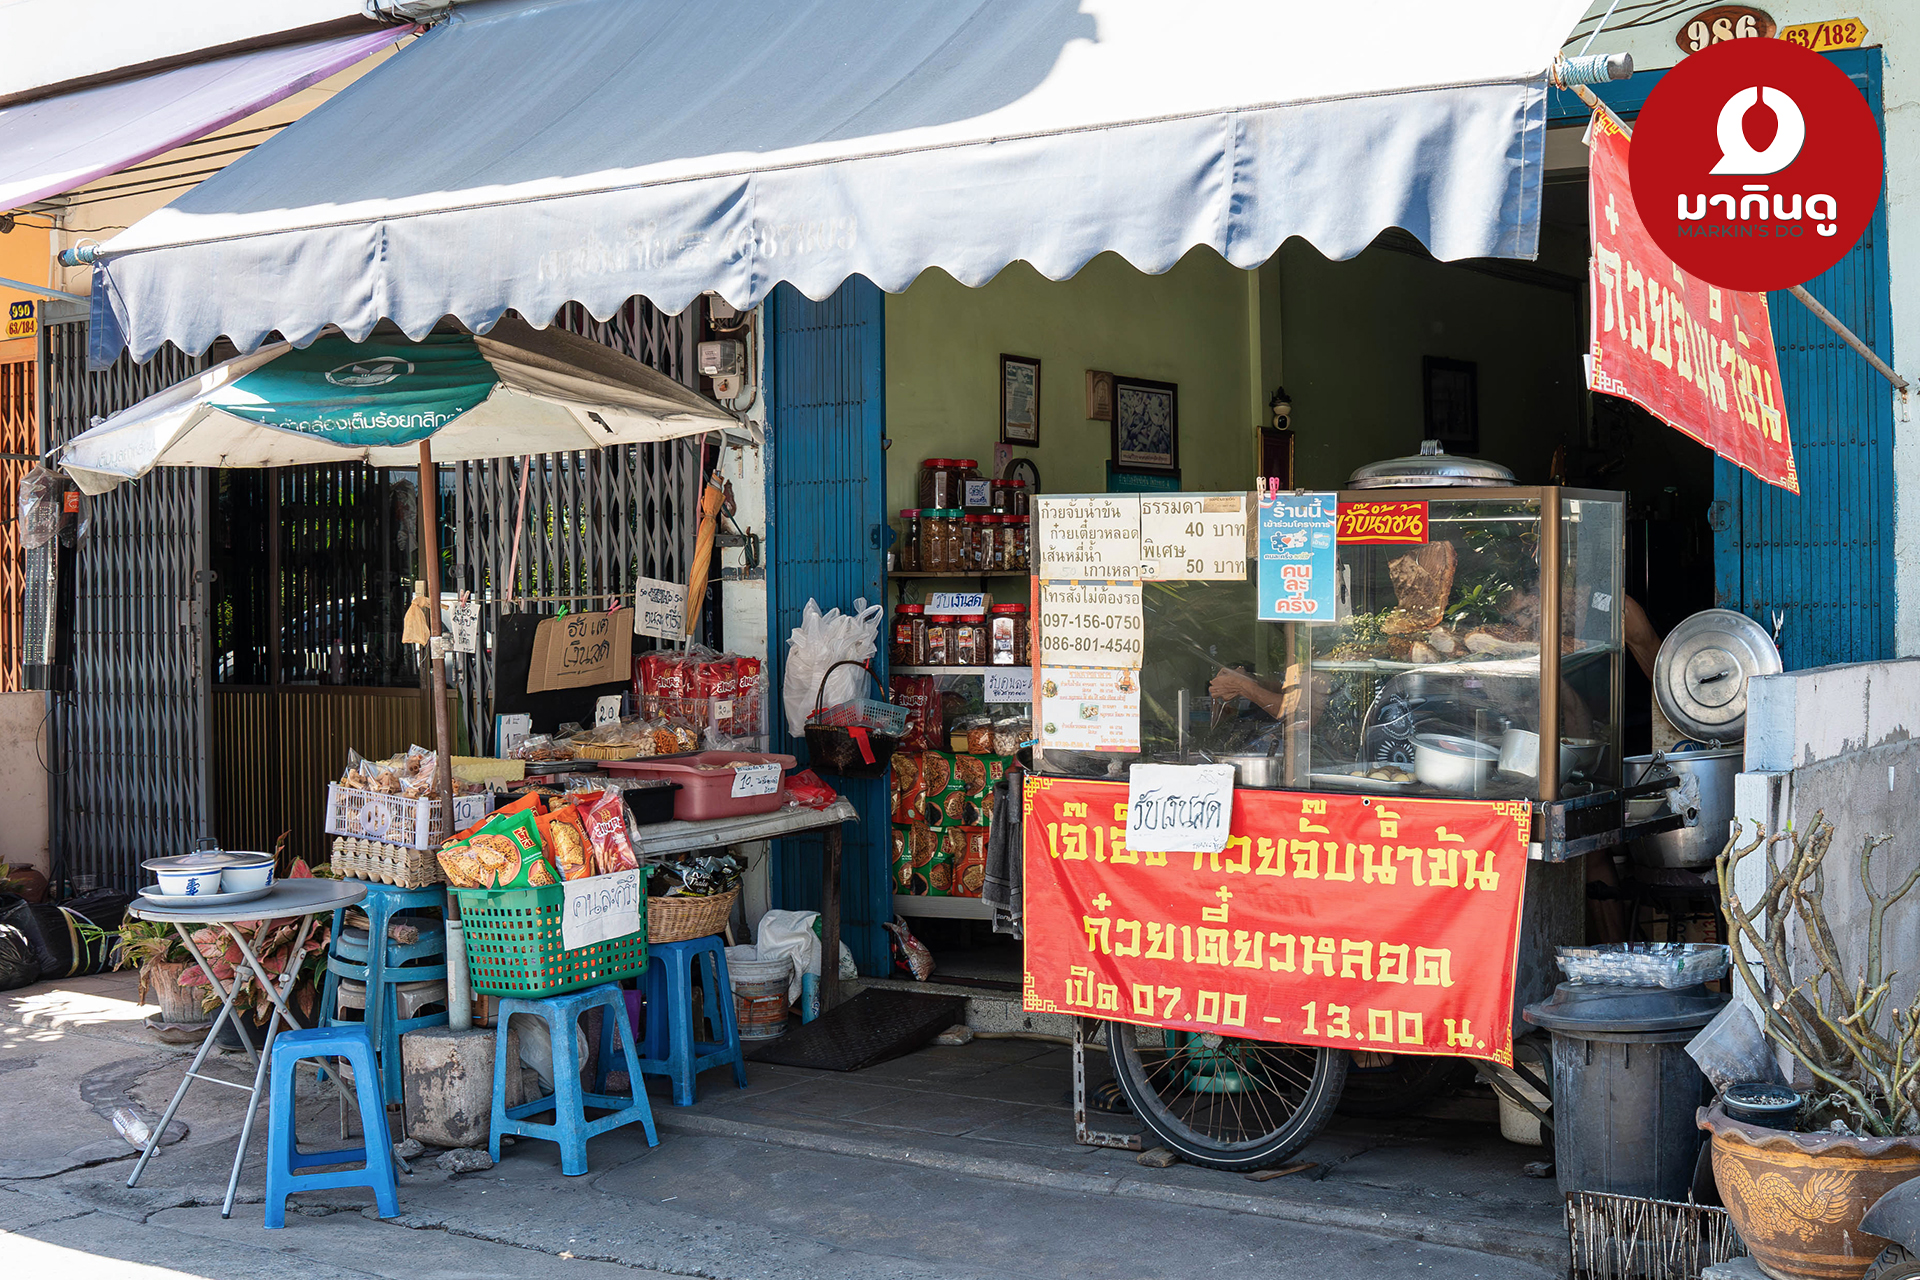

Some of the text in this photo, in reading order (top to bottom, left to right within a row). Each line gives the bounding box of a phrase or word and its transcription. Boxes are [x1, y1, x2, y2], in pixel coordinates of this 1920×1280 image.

[12, 304, 30, 318] 990
[9, 320, 35, 335] 63/184
[1142, 500, 1203, 515] ธรรมดา
[1273, 498, 1322, 518] ร้านนี้
[1050, 519, 1140, 541] ก๋วยเตี๋ยวหลอด
[1185, 521, 1246, 538] 40 บาท
[1263, 519, 1331, 529] เข้าร่วมโครงการ
[1042, 541, 1102, 564] เส้นหมี่น้ำ
[1142, 538, 1187, 559] พิเศษ
[1083, 564, 1140, 578] เกาเหลา
[1186, 559, 1246, 574] 50 บาท
[1282, 565, 1311, 579] คน
[1043, 585, 1140, 605] โทรสังไม่ต้องรอ
[1285, 580, 1308, 592] ละ
[1276, 594, 1317, 613] ครึ่ง
[1043, 613, 1141, 630] 097-156-0750
[1043, 635, 1141, 653] 086-801-4540
[563, 639, 610, 668] เงินสด
[1133, 786, 1222, 831] รับเงินสด
[1193, 799, 1501, 892] วยจั๊บน้ำข้น
[1082, 885, 1456, 989] ก๋วยเตี๋ยวหลอด
[1064, 965, 1120, 1013] เปิด
[1132, 982, 1248, 1028] 07.00
[1301, 1000, 1425, 1046] 13.00
[1442, 1016, 1487, 1050] น.
